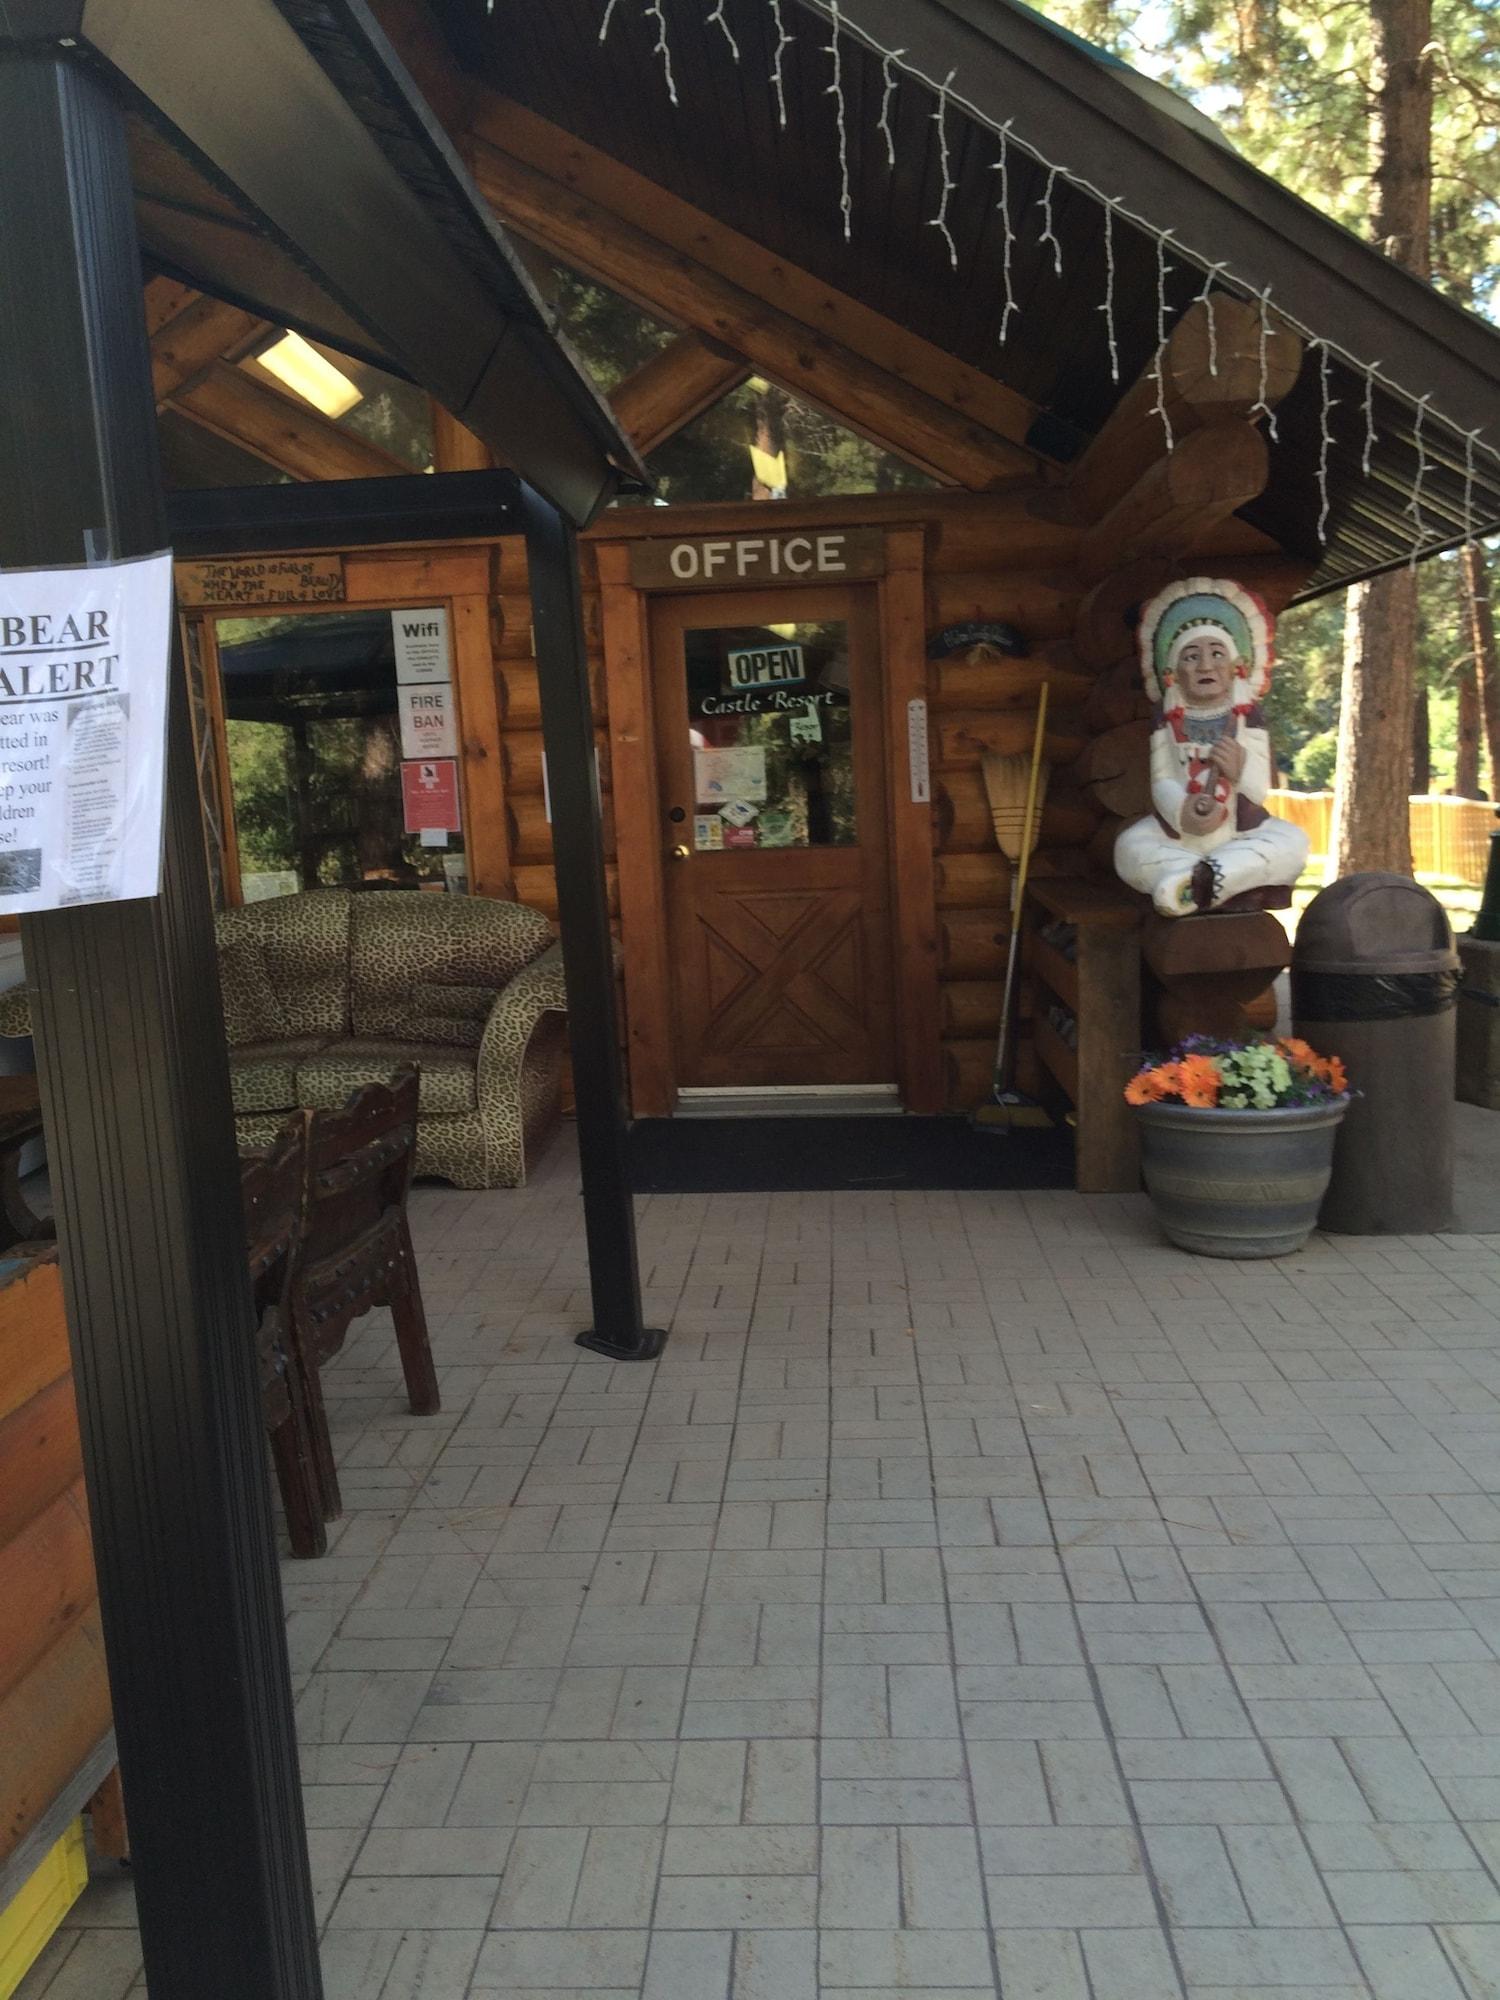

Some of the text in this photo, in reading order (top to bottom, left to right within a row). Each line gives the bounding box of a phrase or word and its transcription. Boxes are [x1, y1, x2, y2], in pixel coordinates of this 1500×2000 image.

[670, 536, 846, 578] OFFICE
[0, 610, 110, 646] BEAR
[402, 622, 439, 637] Wifi
[0, 655, 119, 696] ALERT
[735, 649, 799, 684] OPEN
[410, 695, 444, 709] FIRE
[701, 691, 834, 715] Castle Resort
[29, 710, 59, 723] was
[413, 714, 445, 728] BAN
[33, 731, 48, 747] in
[1, 754, 50, 773] resort!
[19, 781, 52, 800] your
